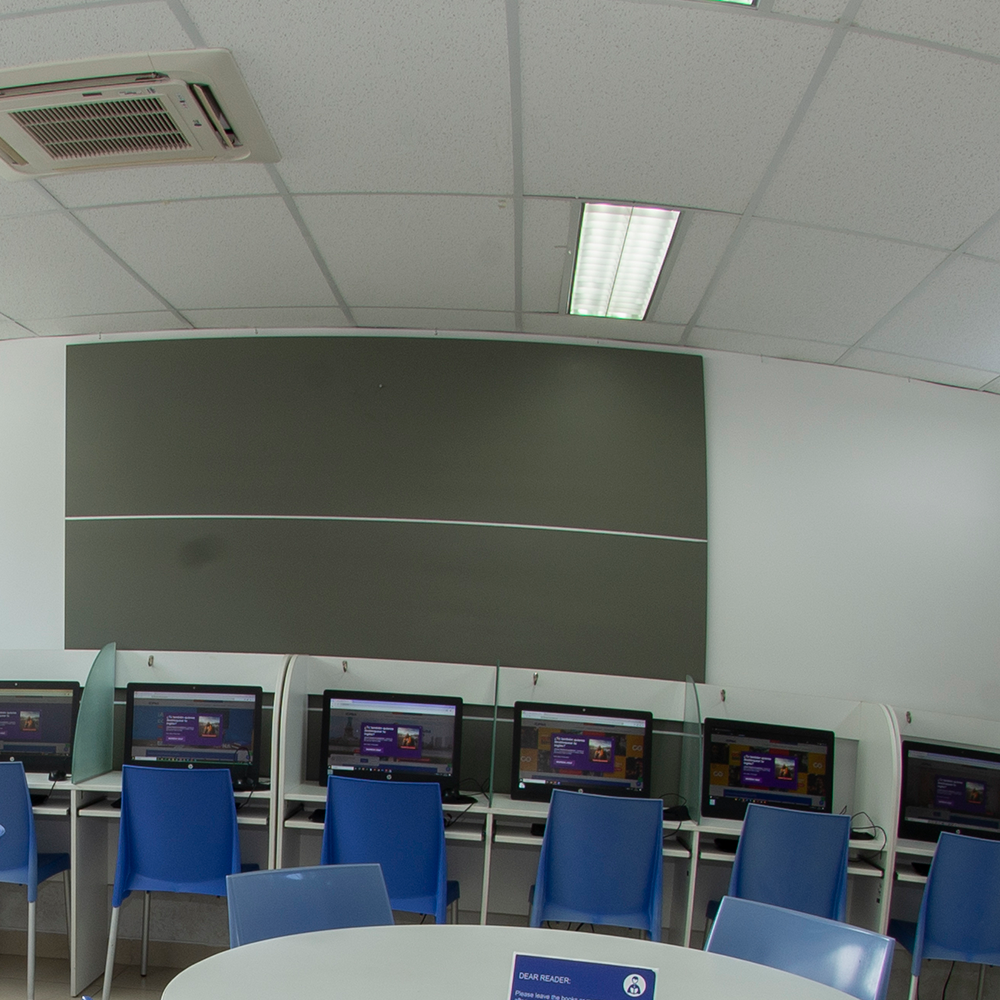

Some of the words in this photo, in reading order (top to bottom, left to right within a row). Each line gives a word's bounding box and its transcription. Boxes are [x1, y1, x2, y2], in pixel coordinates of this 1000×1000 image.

[518, 972, 539, 981] DEAR
[540, 974, 572, 984] READER:
[515, 990, 535, 998] Please
[535, 992, 550, 1000] leave
